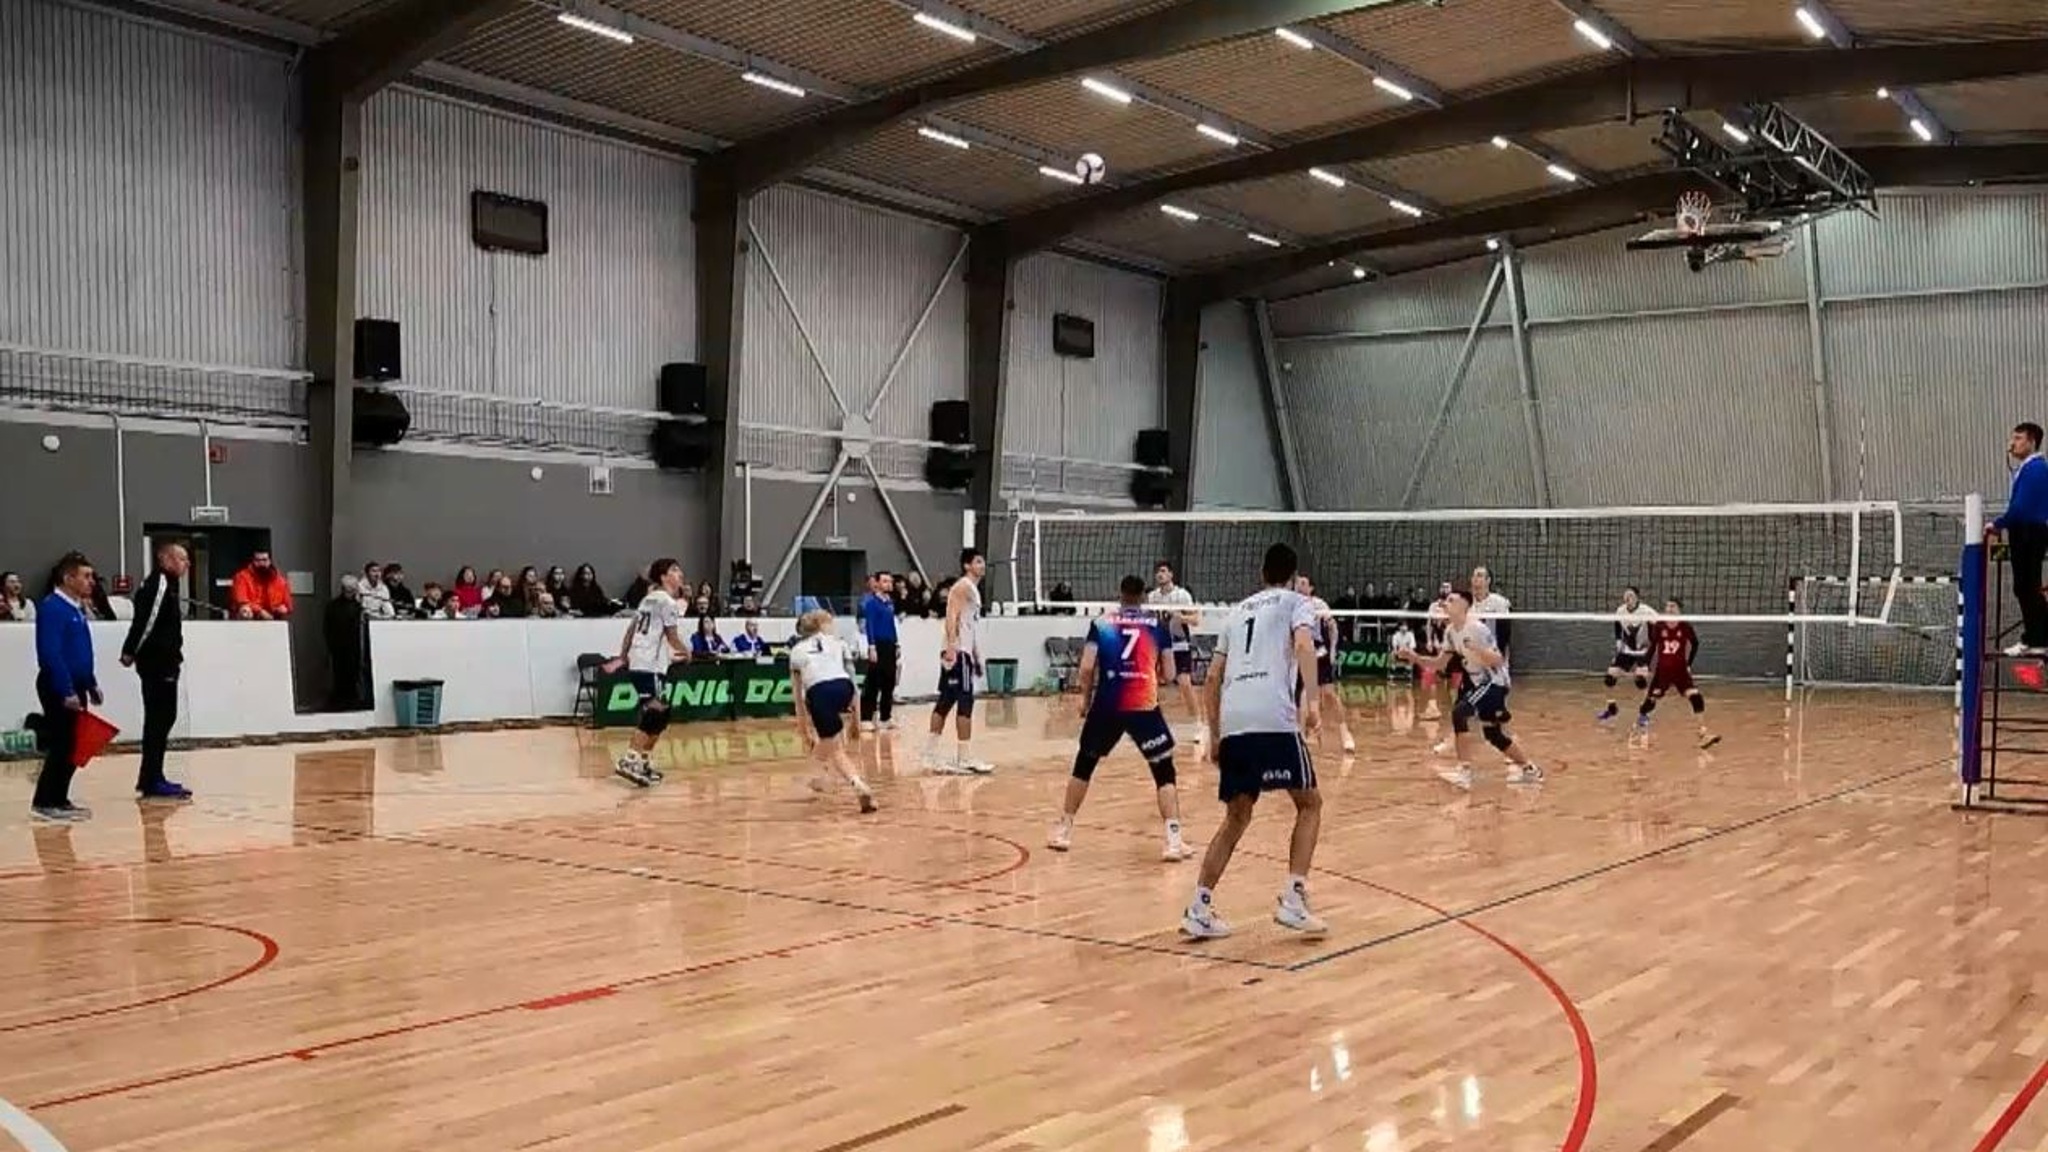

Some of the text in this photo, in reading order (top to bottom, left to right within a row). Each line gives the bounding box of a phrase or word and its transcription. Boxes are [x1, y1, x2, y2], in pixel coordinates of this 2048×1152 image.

[1121, 629, 1140, 659] 7
[1244, 617, 1255, 654] 1
[1662, 640, 1680, 654] 19
